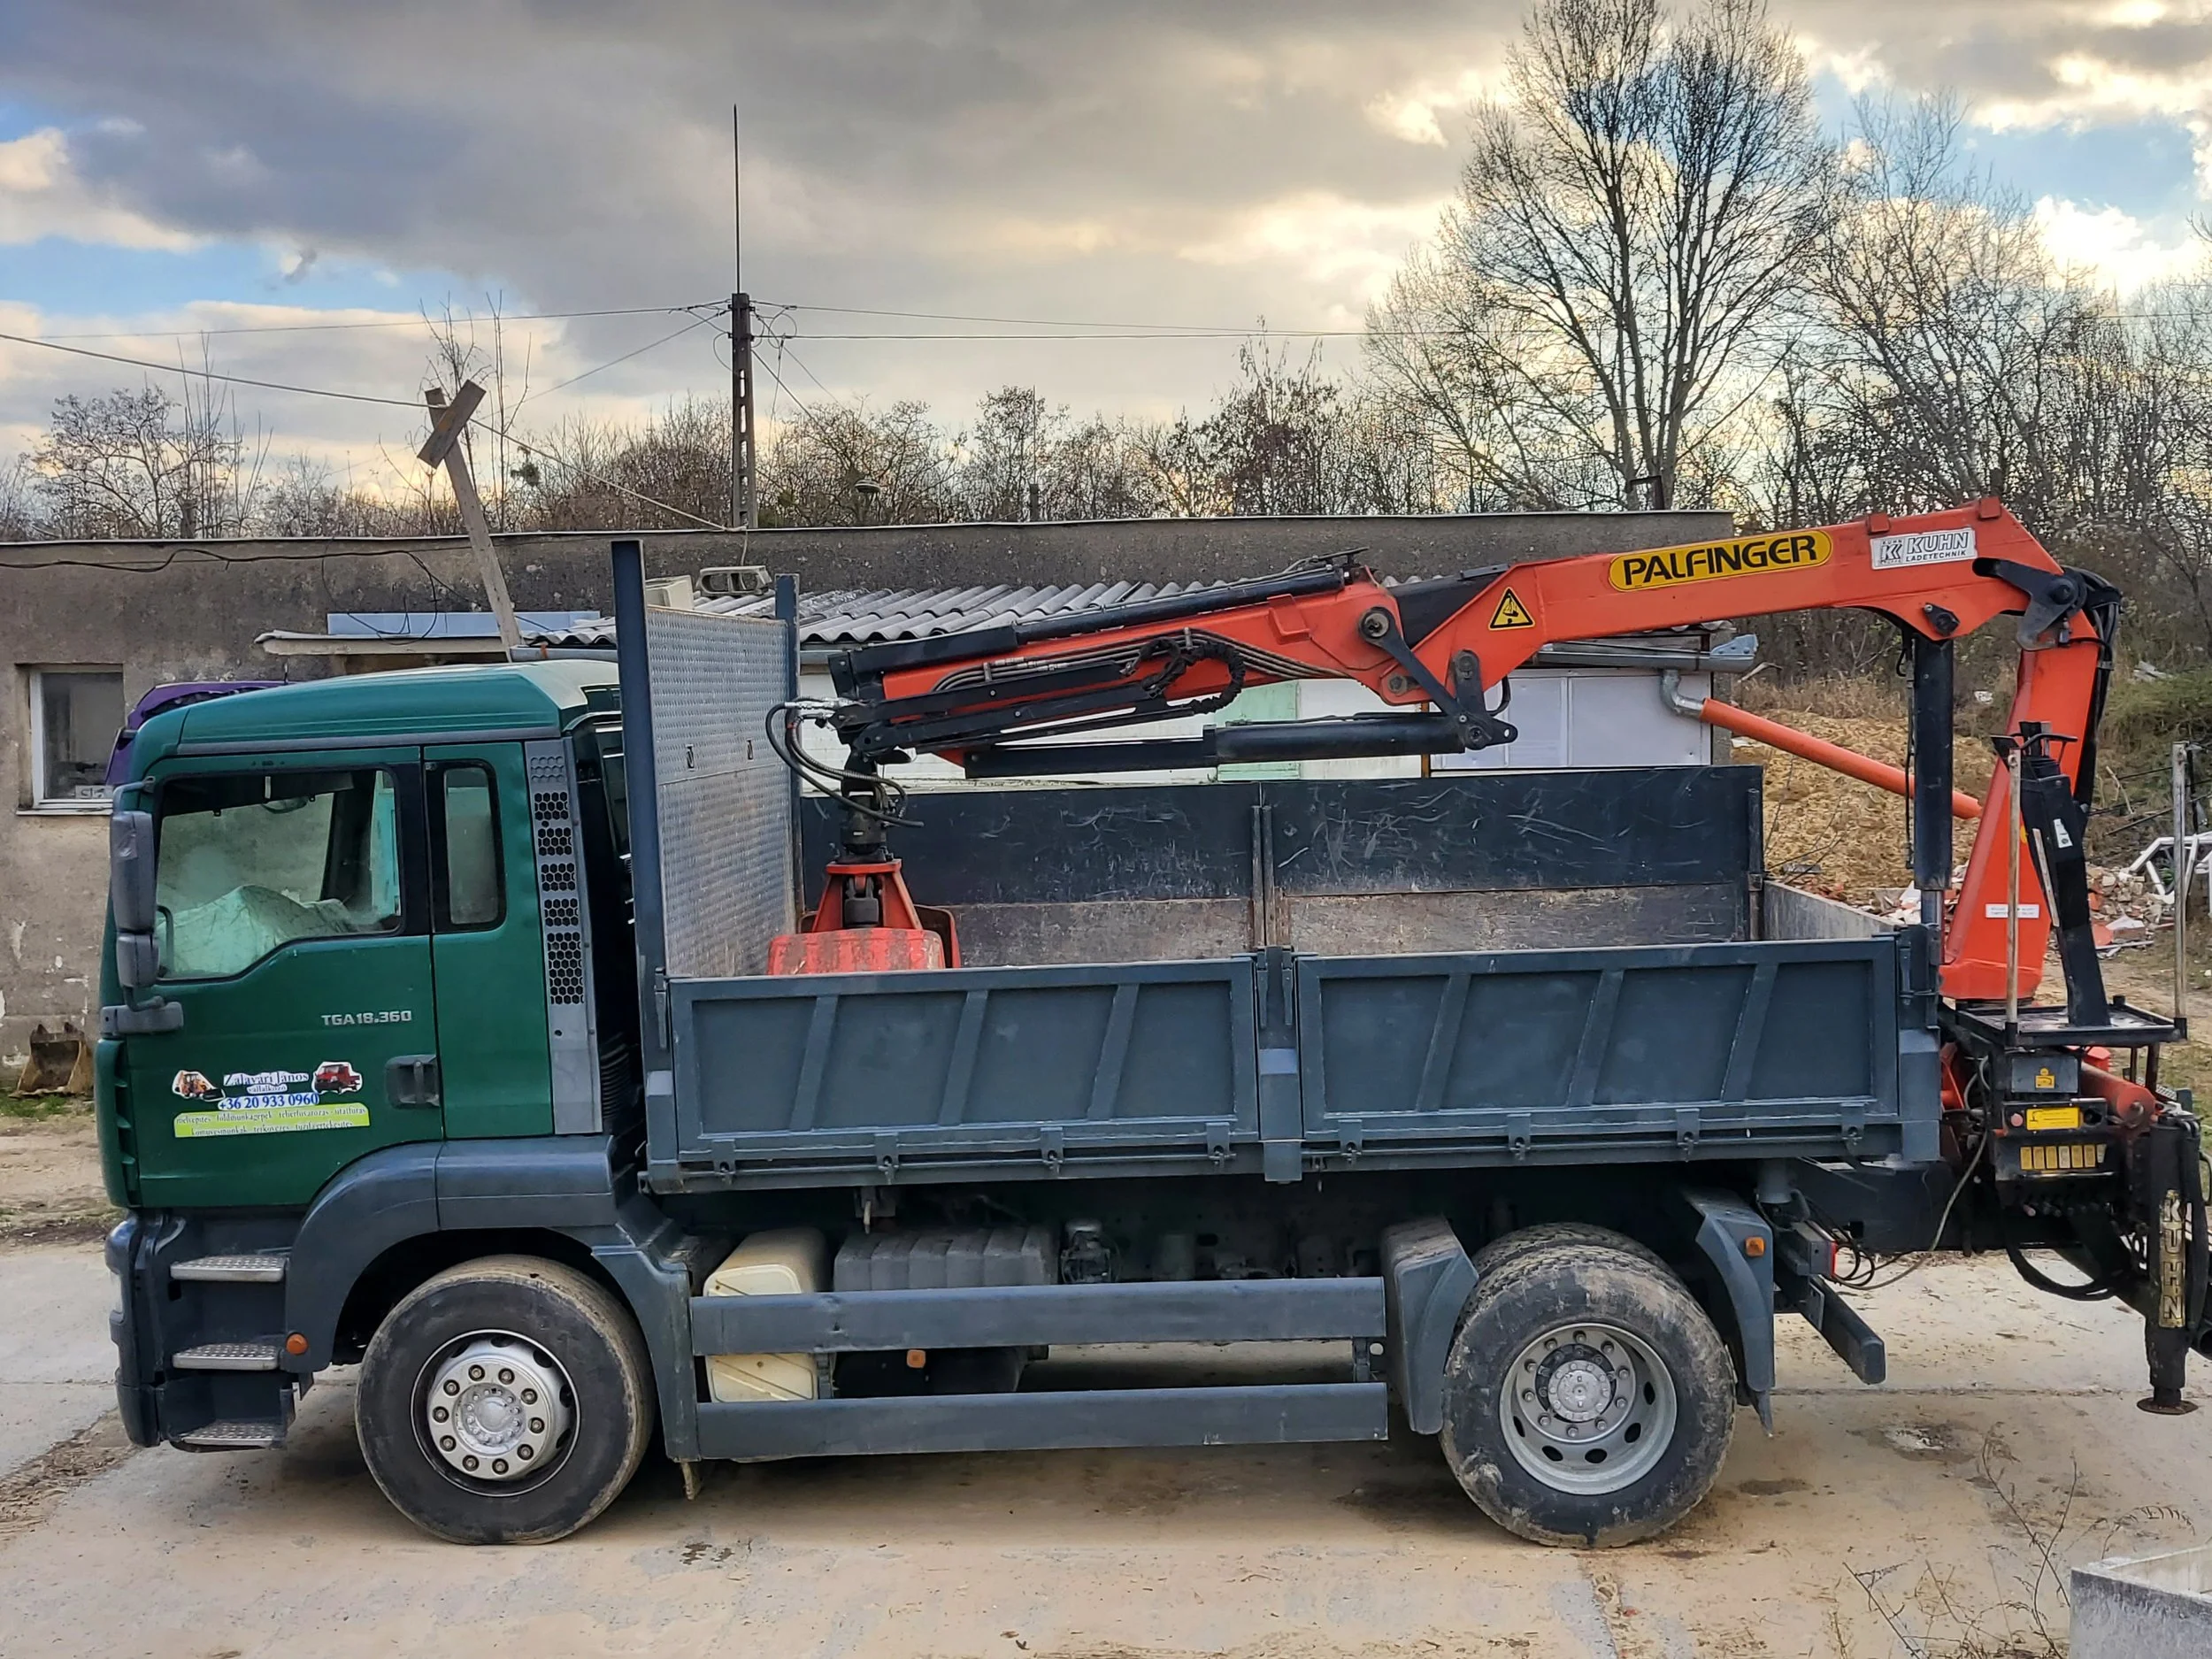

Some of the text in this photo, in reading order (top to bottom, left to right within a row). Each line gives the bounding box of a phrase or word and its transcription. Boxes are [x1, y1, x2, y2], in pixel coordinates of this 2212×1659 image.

[1906, 531, 1969, 554] KUHN
[1623, 534, 1817, 587] PALFINGER
[1905, 550, 1966, 562] LADETECHNIK
[219, 1093, 319, 1110] +36 20 933 0960
[2162, 1198, 2185, 1320] KUHN
